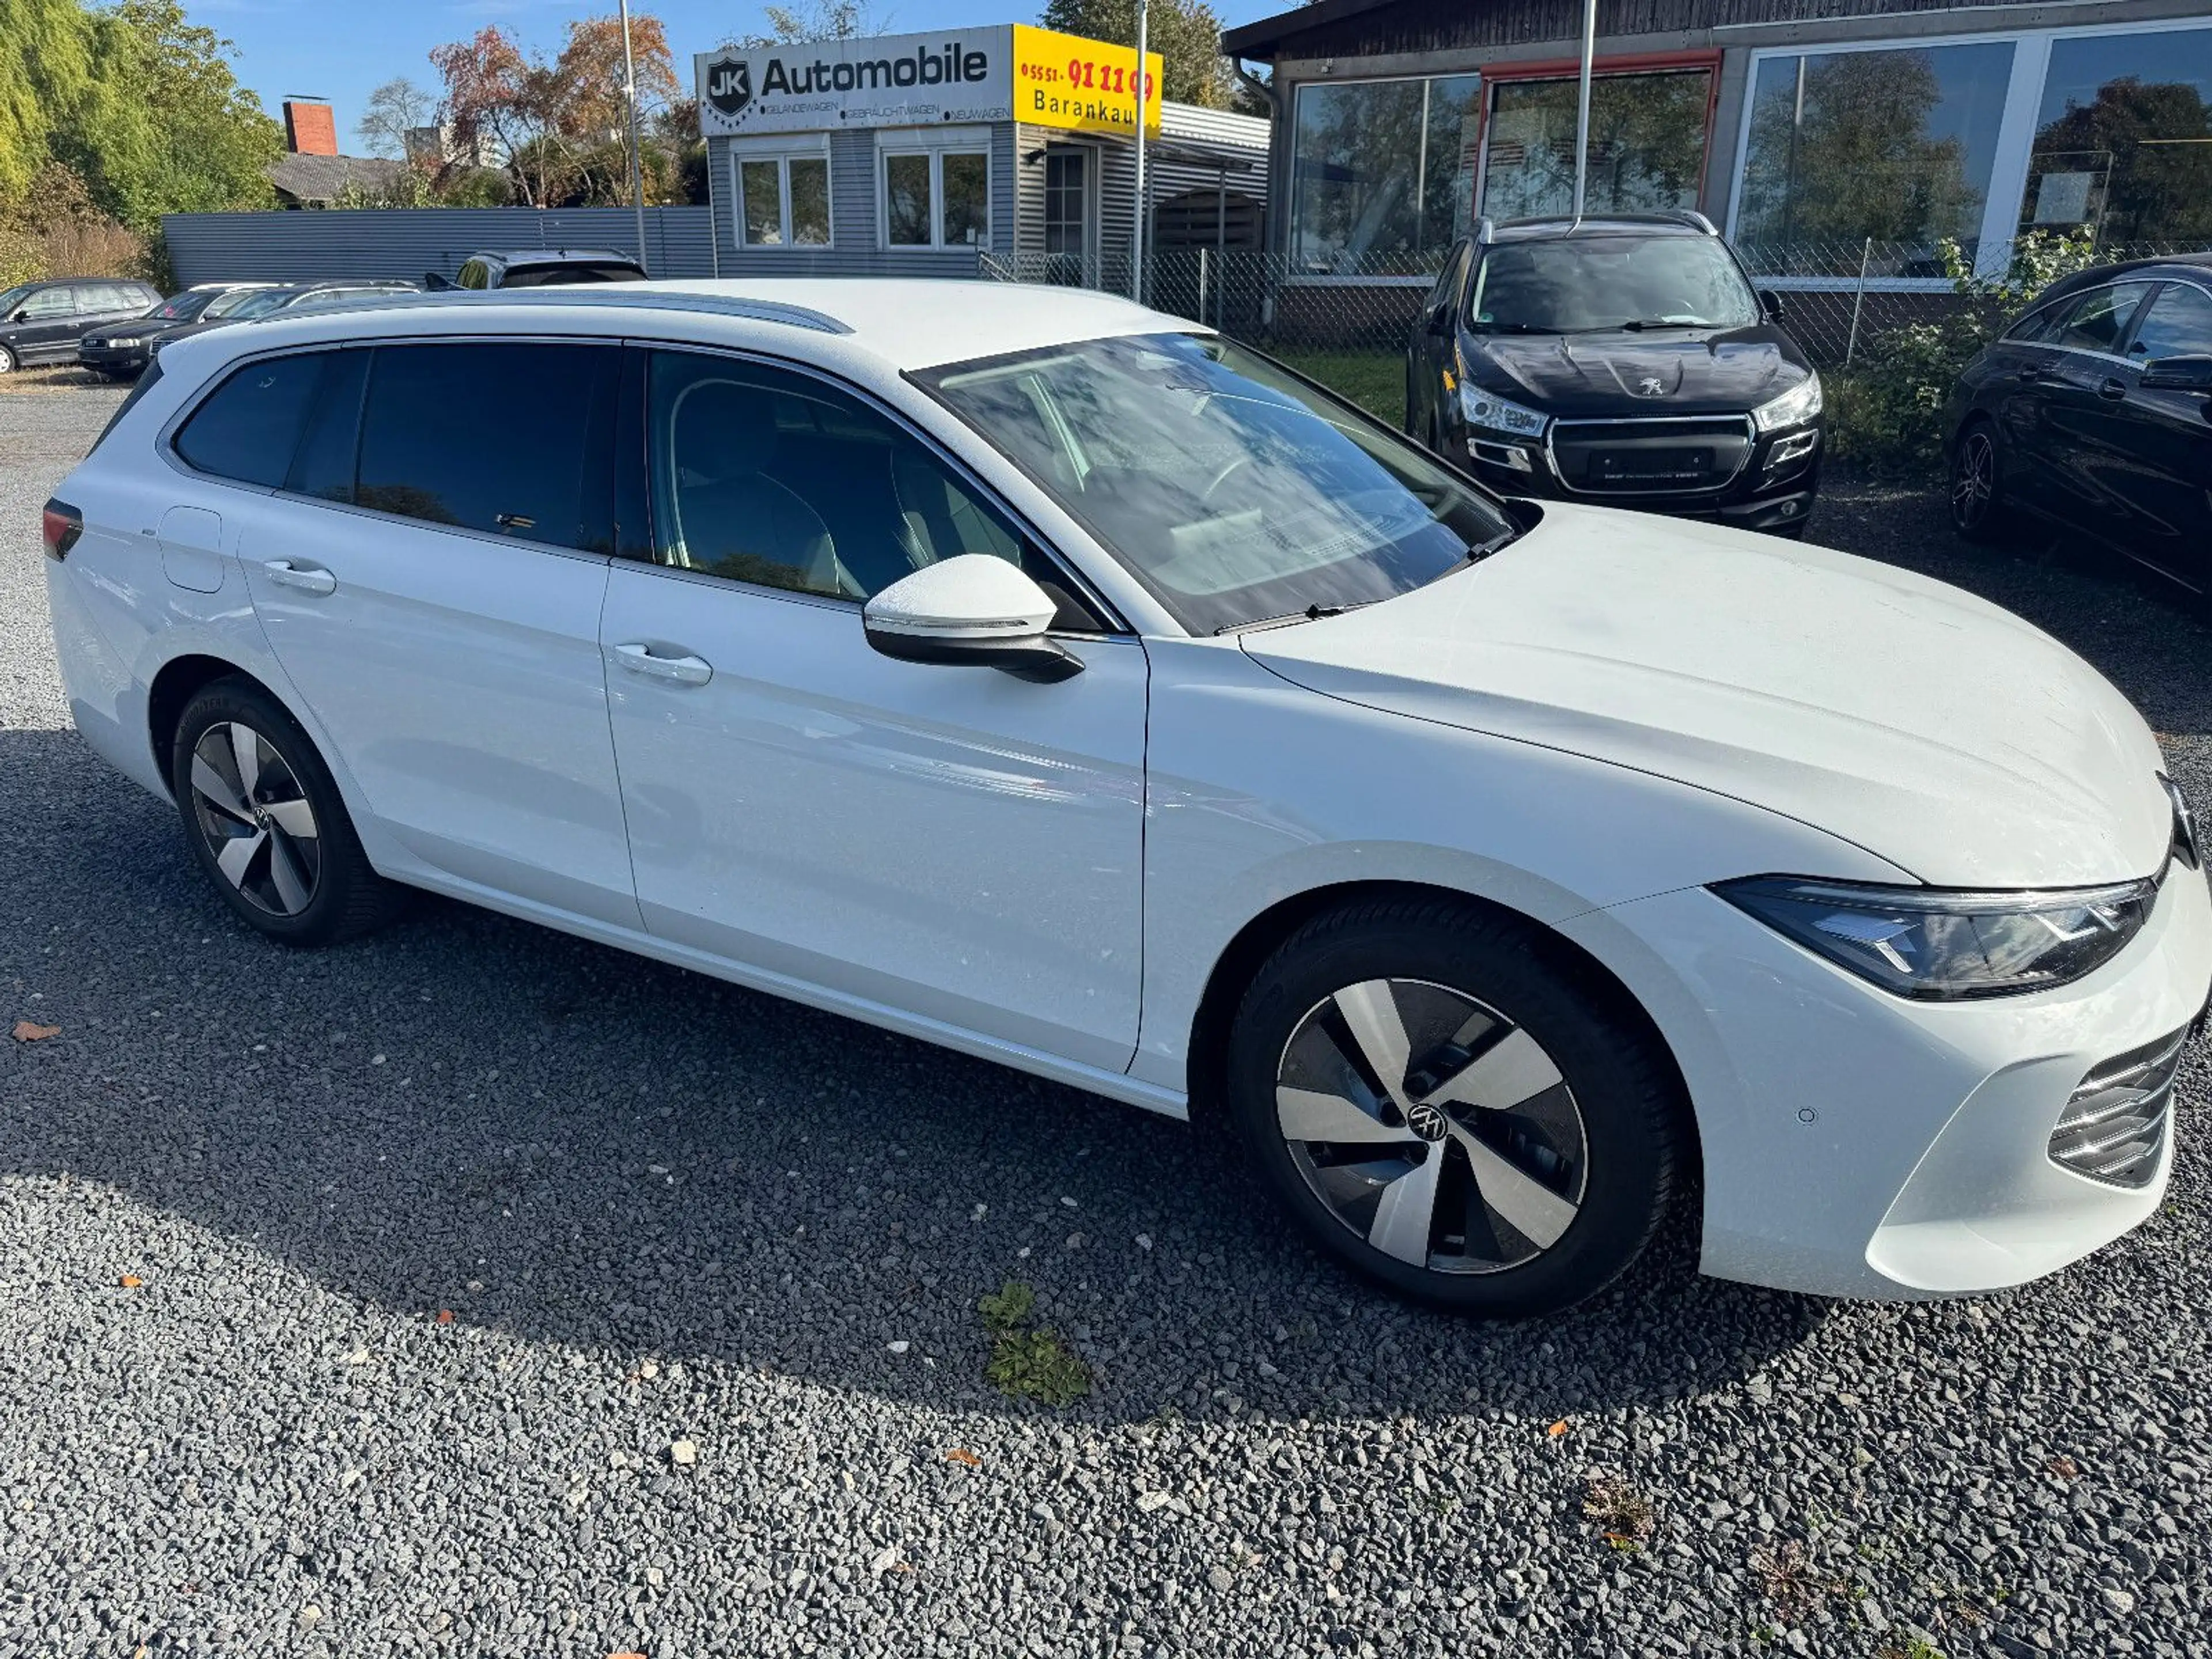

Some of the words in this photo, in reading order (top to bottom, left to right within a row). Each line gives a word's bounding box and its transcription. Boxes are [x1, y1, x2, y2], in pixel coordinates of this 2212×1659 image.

[710, 70, 747, 96] JK
[761, 42, 987, 96] Automobile
[951, 107, 1010, 121] NEUWAGEN
[1035, 89, 1132, 125] Barankau
